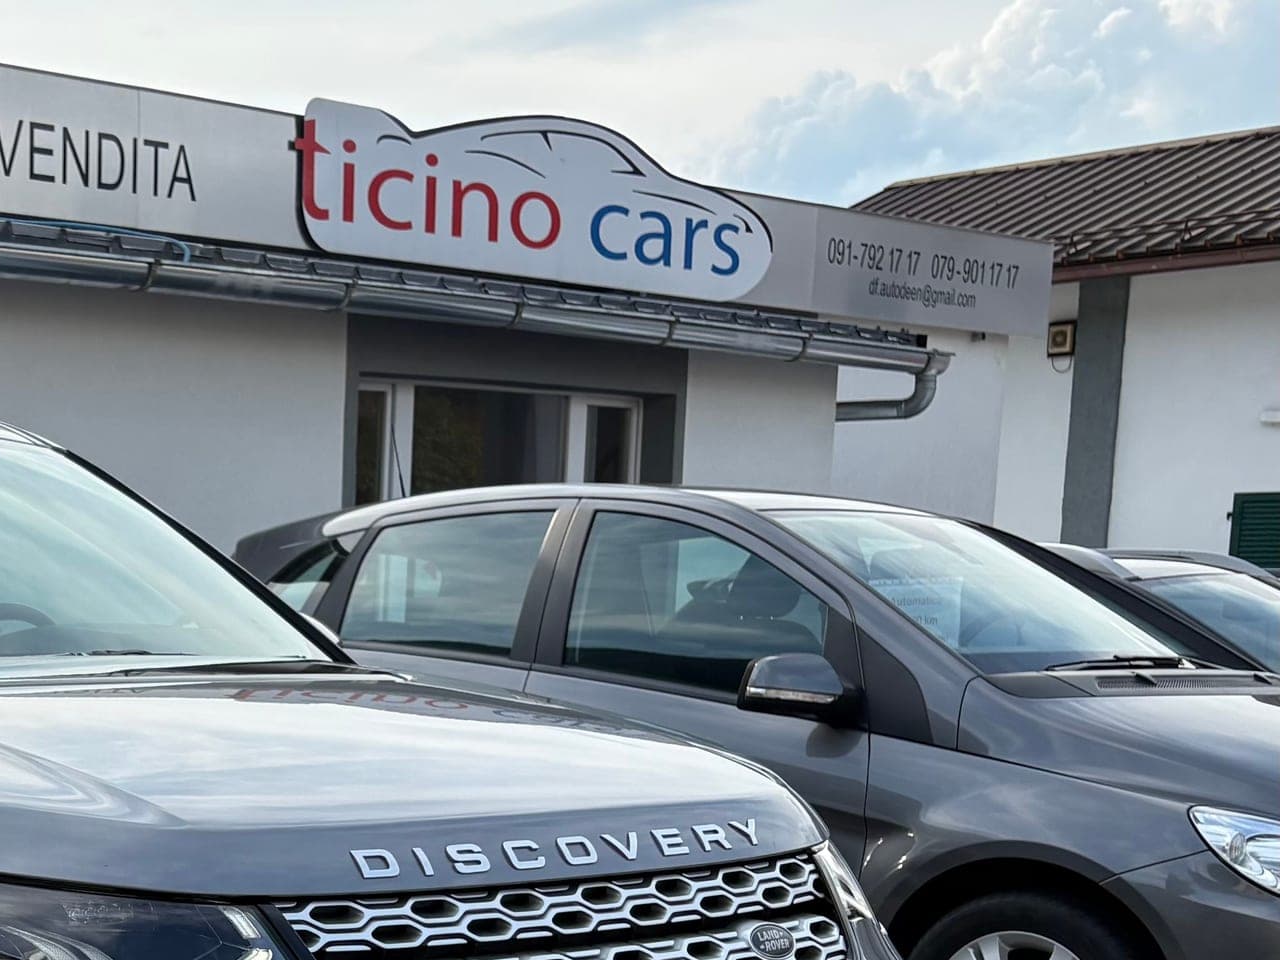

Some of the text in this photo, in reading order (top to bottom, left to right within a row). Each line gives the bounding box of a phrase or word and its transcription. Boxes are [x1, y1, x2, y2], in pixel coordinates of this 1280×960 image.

[293, 118, 740, 276] ticino cars
[827, 237, 1020, 290] 091-792 17 17 079-901 17 17
[350, 818, 760, 880] DISCOVERY
[757, 929, 780, 941] LAND
[765, 938, 790, 952] ROVER
